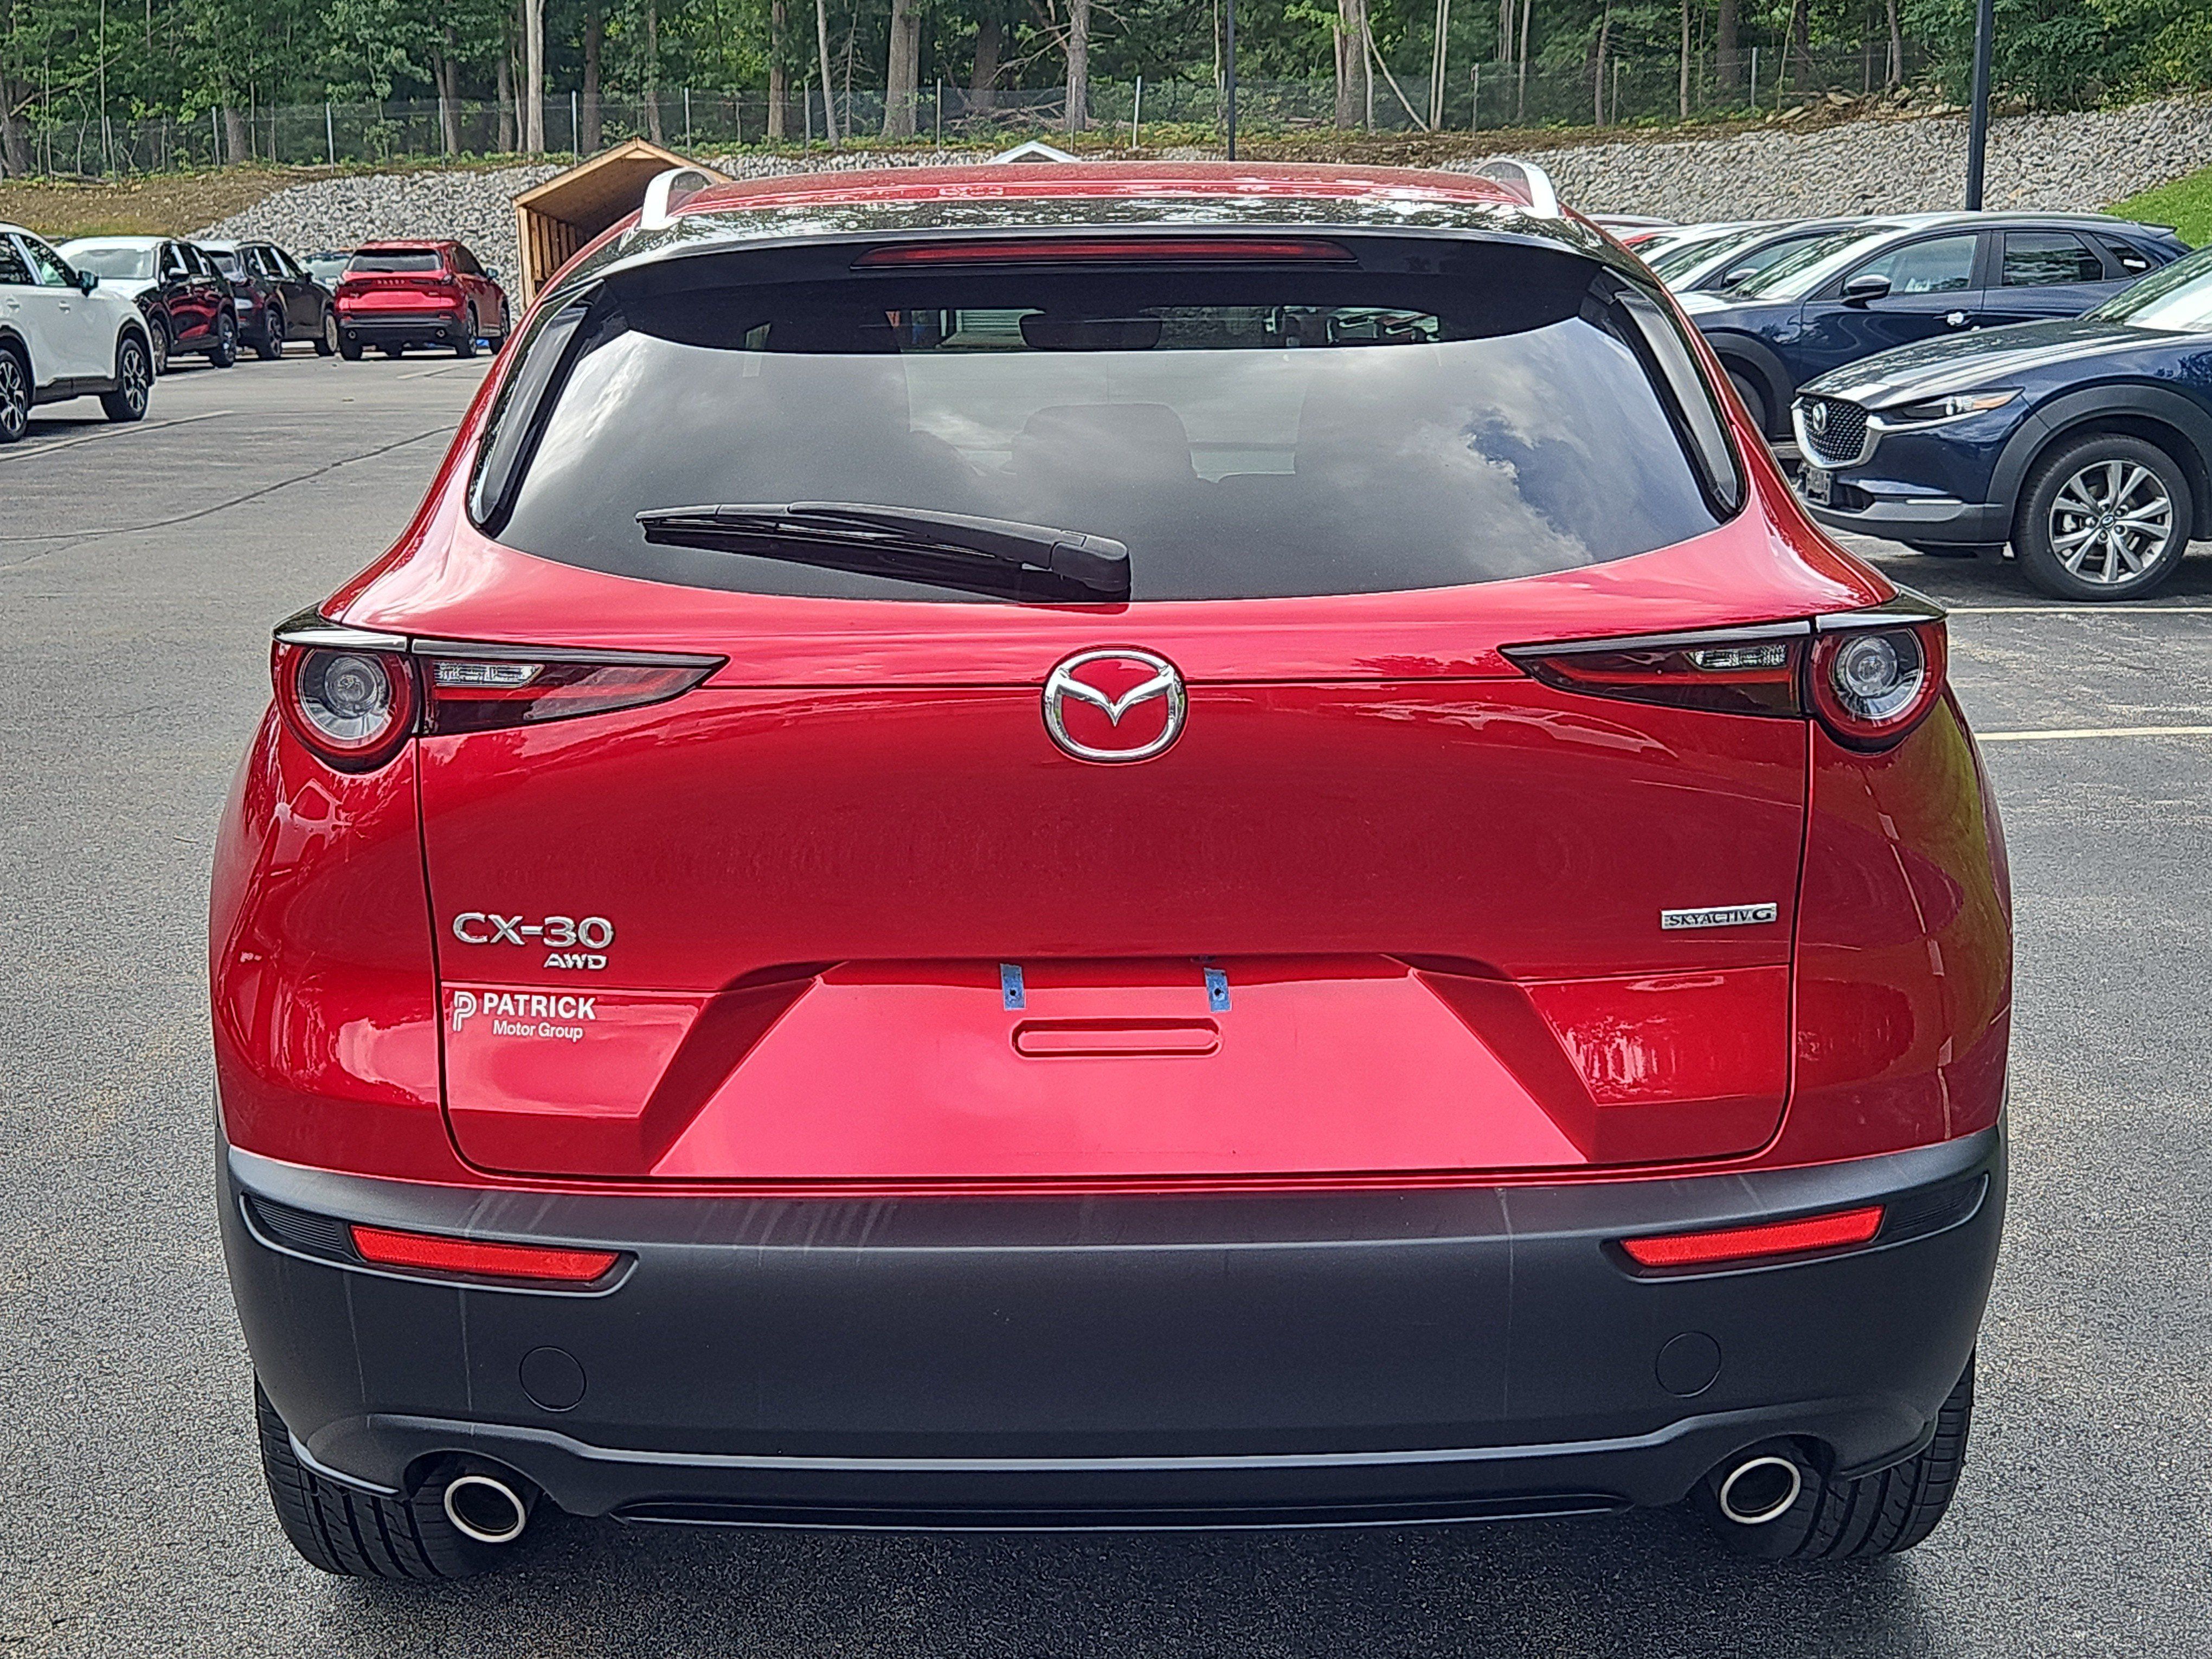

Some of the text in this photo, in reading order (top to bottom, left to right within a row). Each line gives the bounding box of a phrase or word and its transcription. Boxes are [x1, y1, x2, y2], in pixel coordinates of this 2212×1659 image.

[452, 912, 614, 949] CX-30
[543, 953, 607, 969] AWD
[483, 992, 596, 1020] PATRICK
[492, 1019, 583, 1043] Motor Group
